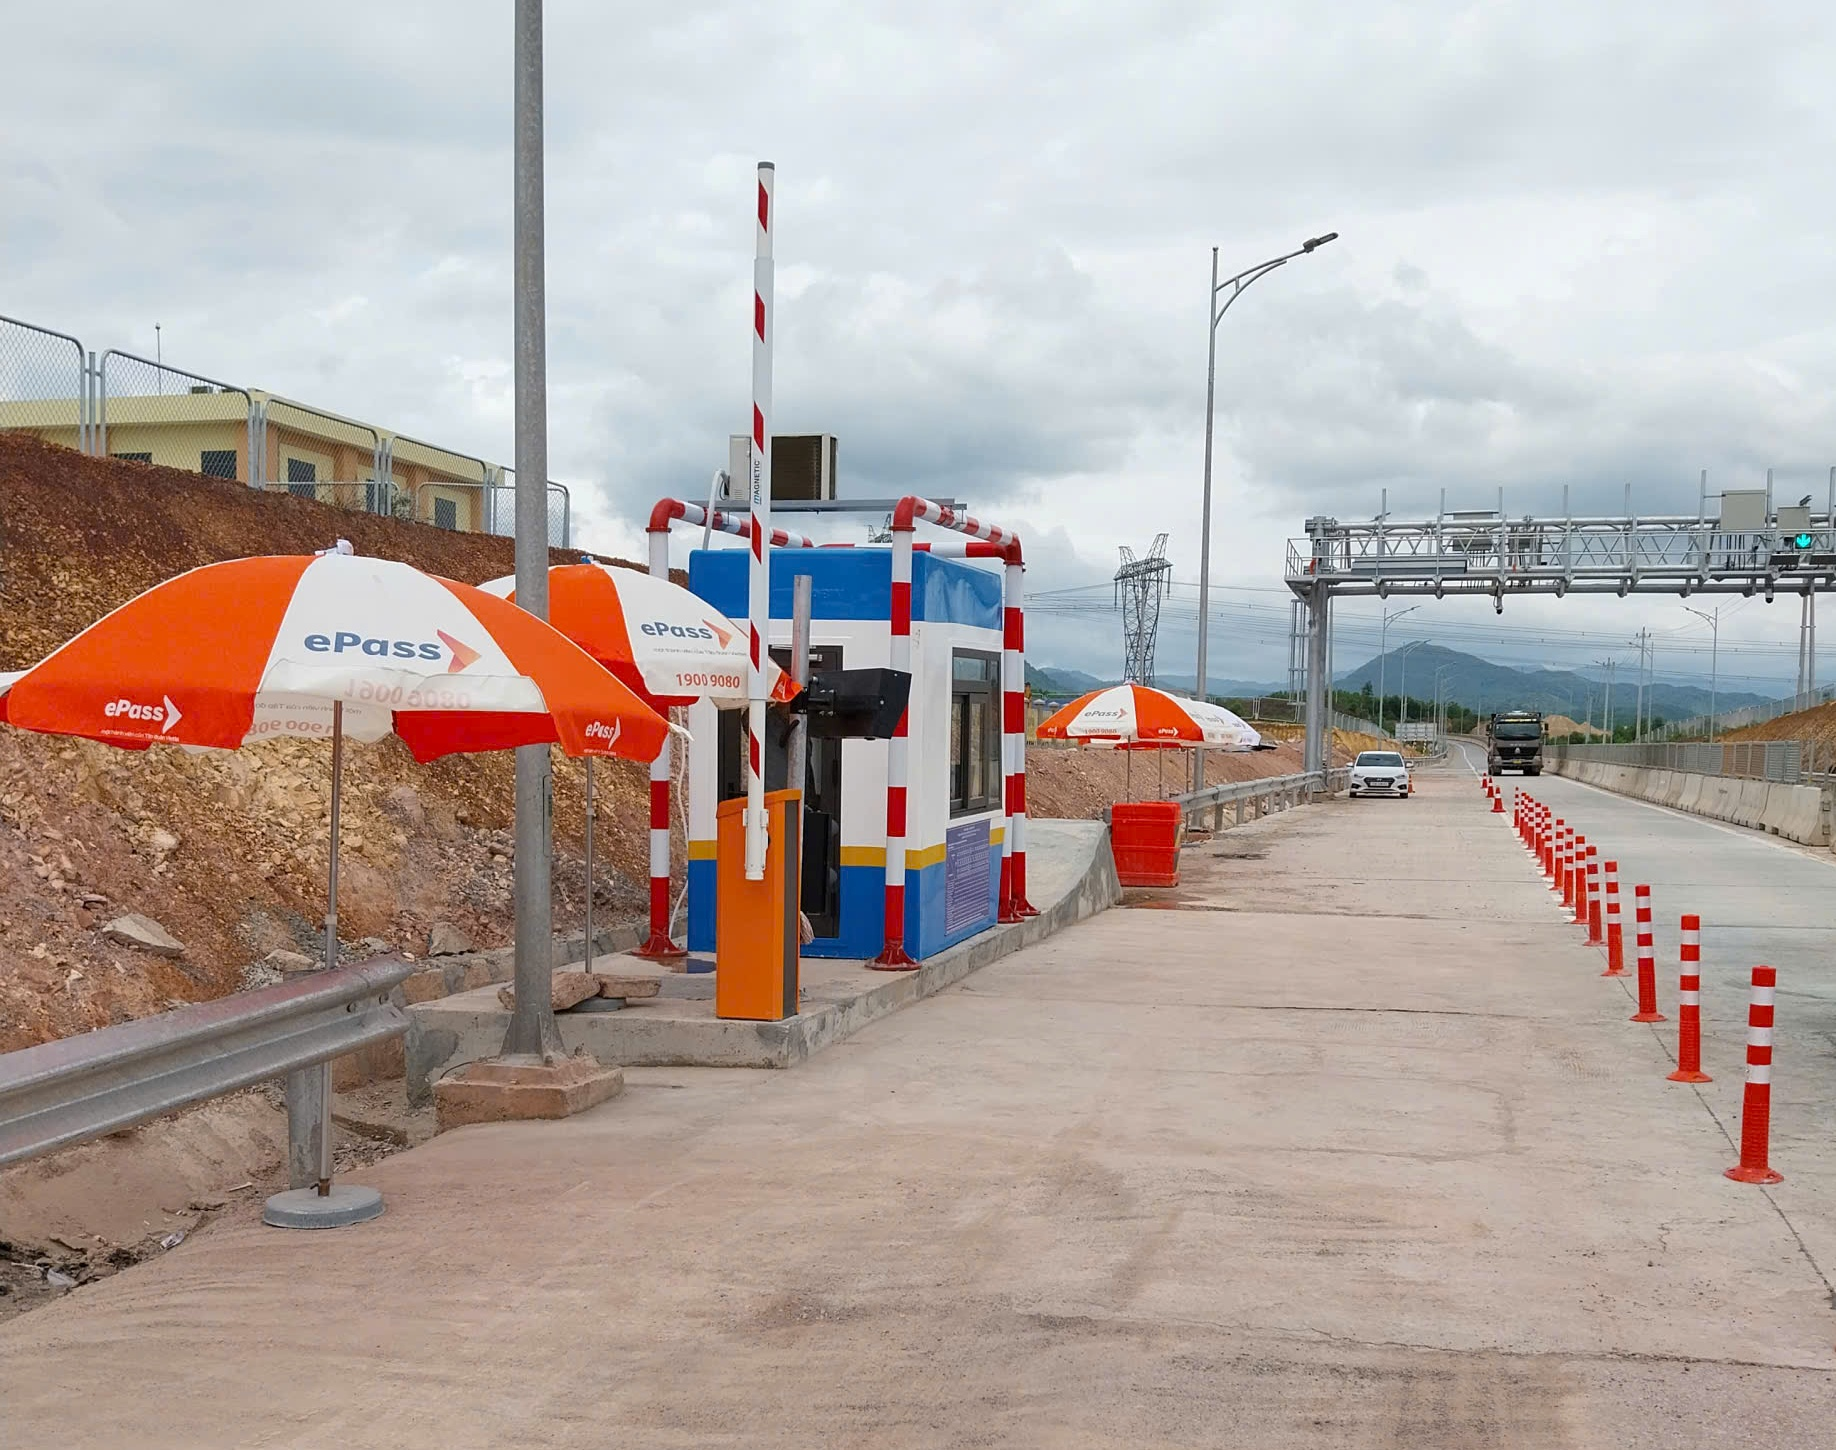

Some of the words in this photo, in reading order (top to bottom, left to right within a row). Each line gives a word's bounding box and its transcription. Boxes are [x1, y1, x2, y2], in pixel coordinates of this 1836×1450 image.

[641, 621, 713, 640] ePass
[304, 631, 442, 661] ePass
[676, 673, 708, 687] 1900
[710, 674, 740, 688] 9080
[104, 699, 164, 721] ePass
